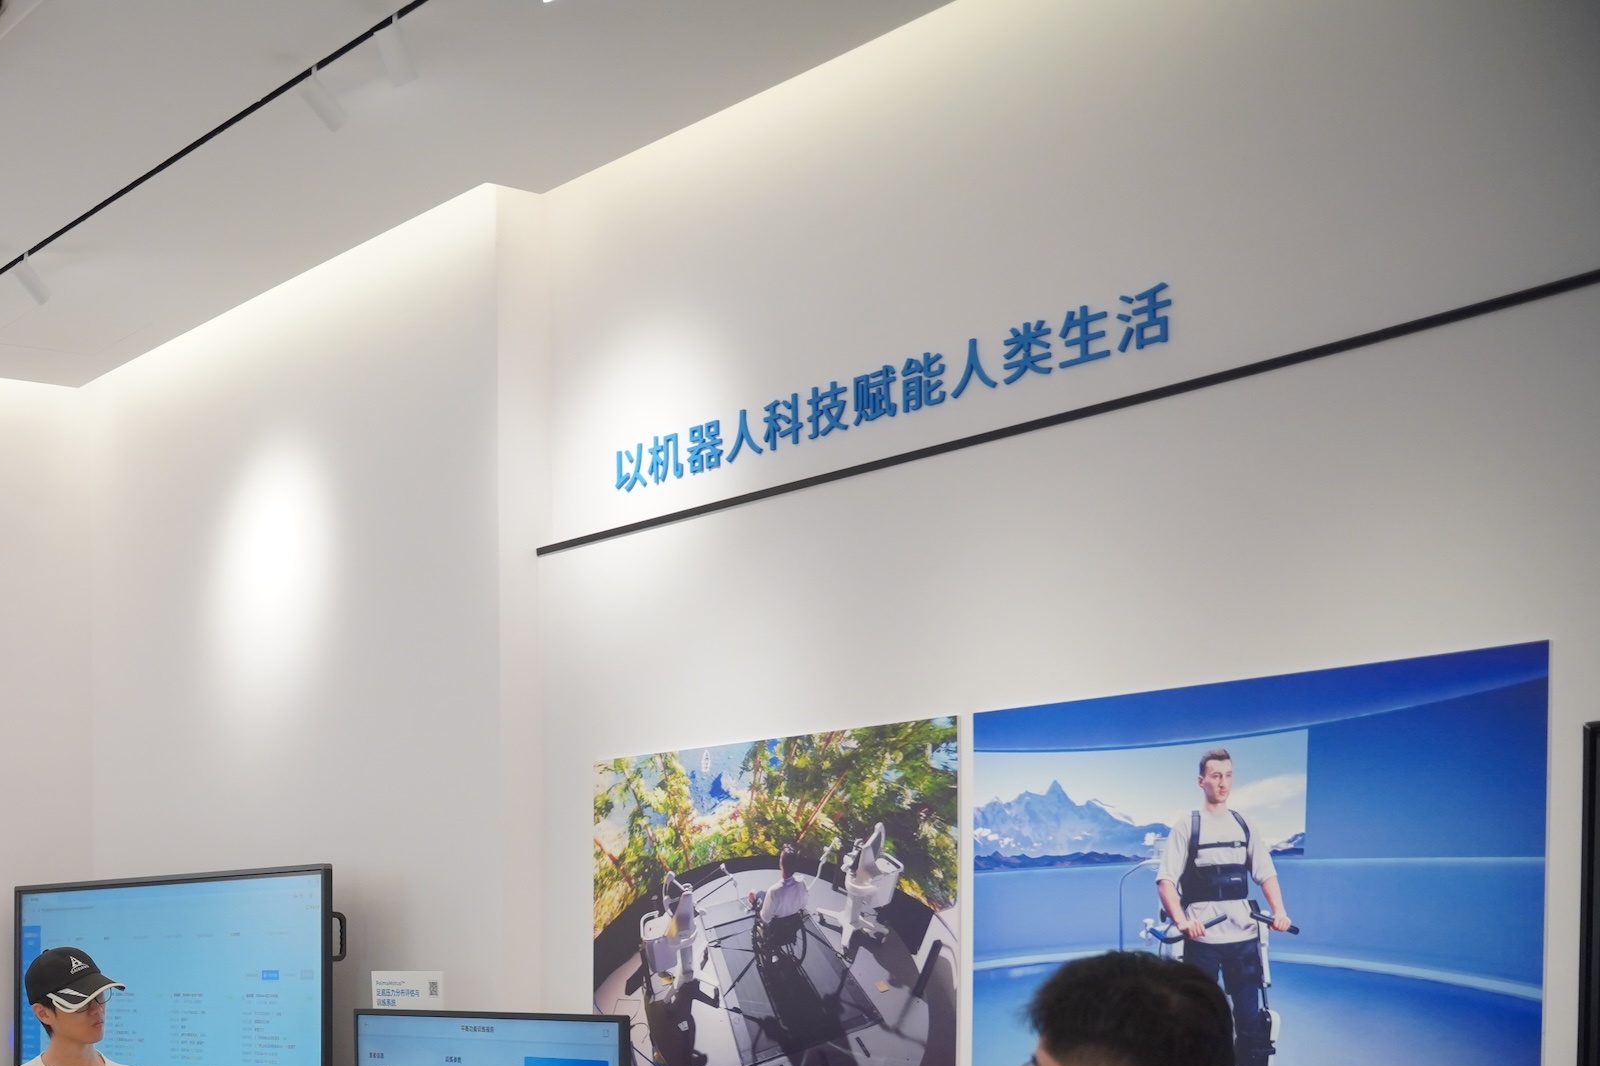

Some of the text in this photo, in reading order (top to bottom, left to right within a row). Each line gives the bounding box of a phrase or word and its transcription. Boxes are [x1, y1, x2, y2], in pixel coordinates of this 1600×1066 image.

[615, 281, 1172, 493] 以机器人科技赋能人类生活
